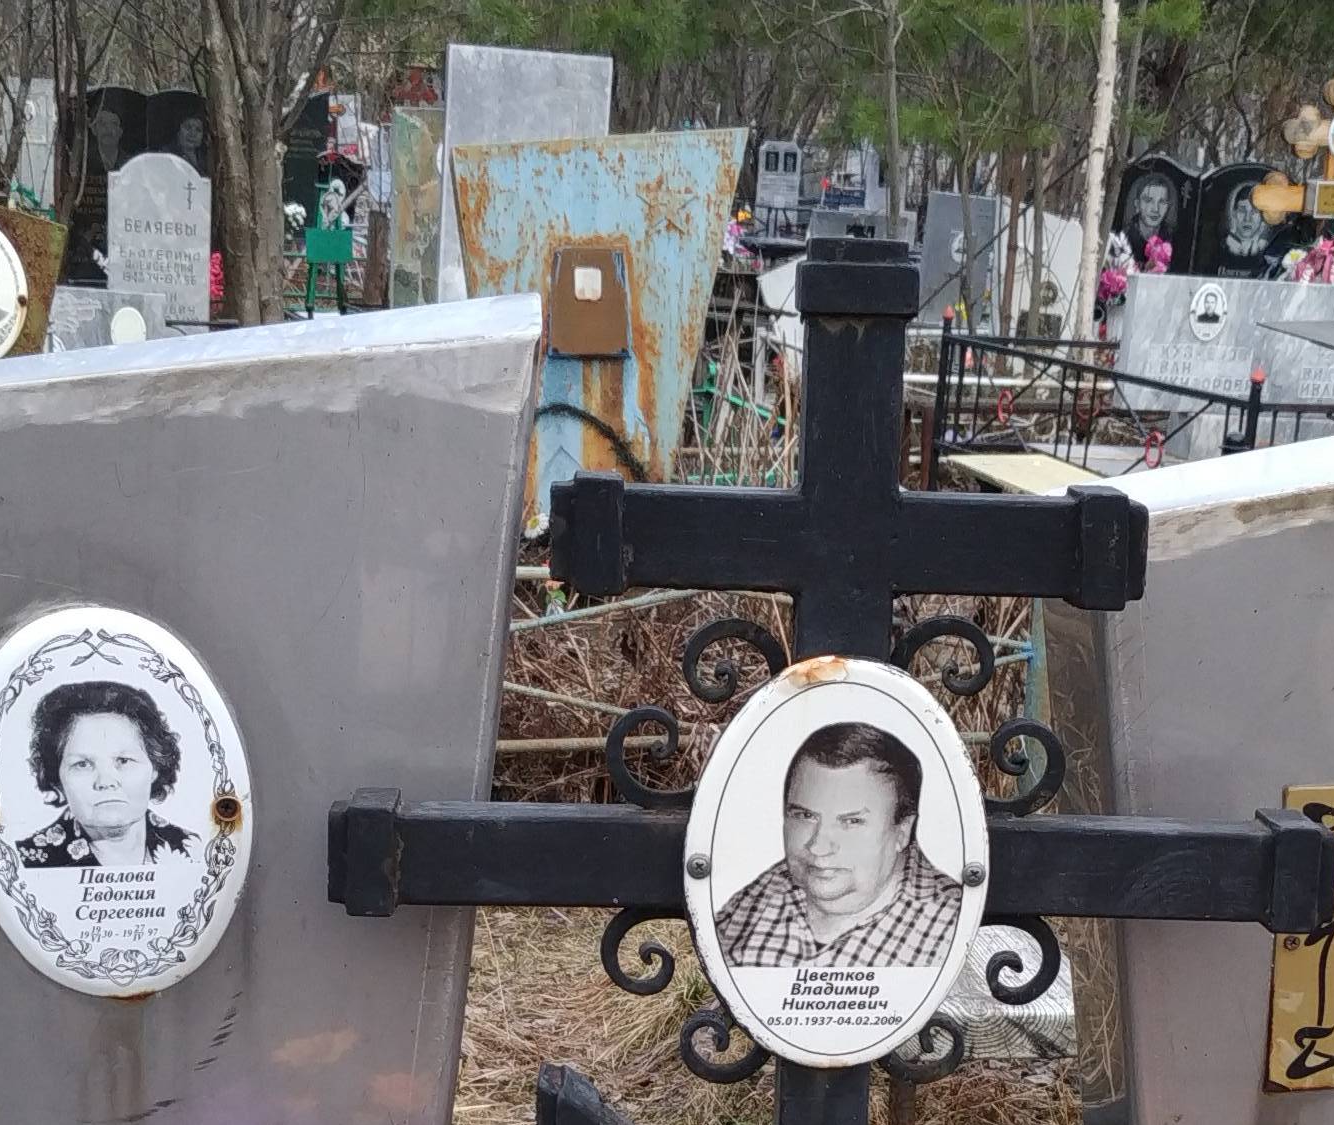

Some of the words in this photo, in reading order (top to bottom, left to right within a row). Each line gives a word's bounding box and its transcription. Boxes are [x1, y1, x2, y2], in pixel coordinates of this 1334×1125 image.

[124, 218, 197, 237] БЕЛЯЕВЫ
[79, 868, 156, 885] Павлова
[82, 886, 156, 902] Евдокия
[75, 904, 166, 924] Сергеевна
[796, 968, 875, 983] Цветков
[790, 982, 880, 998] Владимир
[781, 998, 889, 1011] Николаевич
